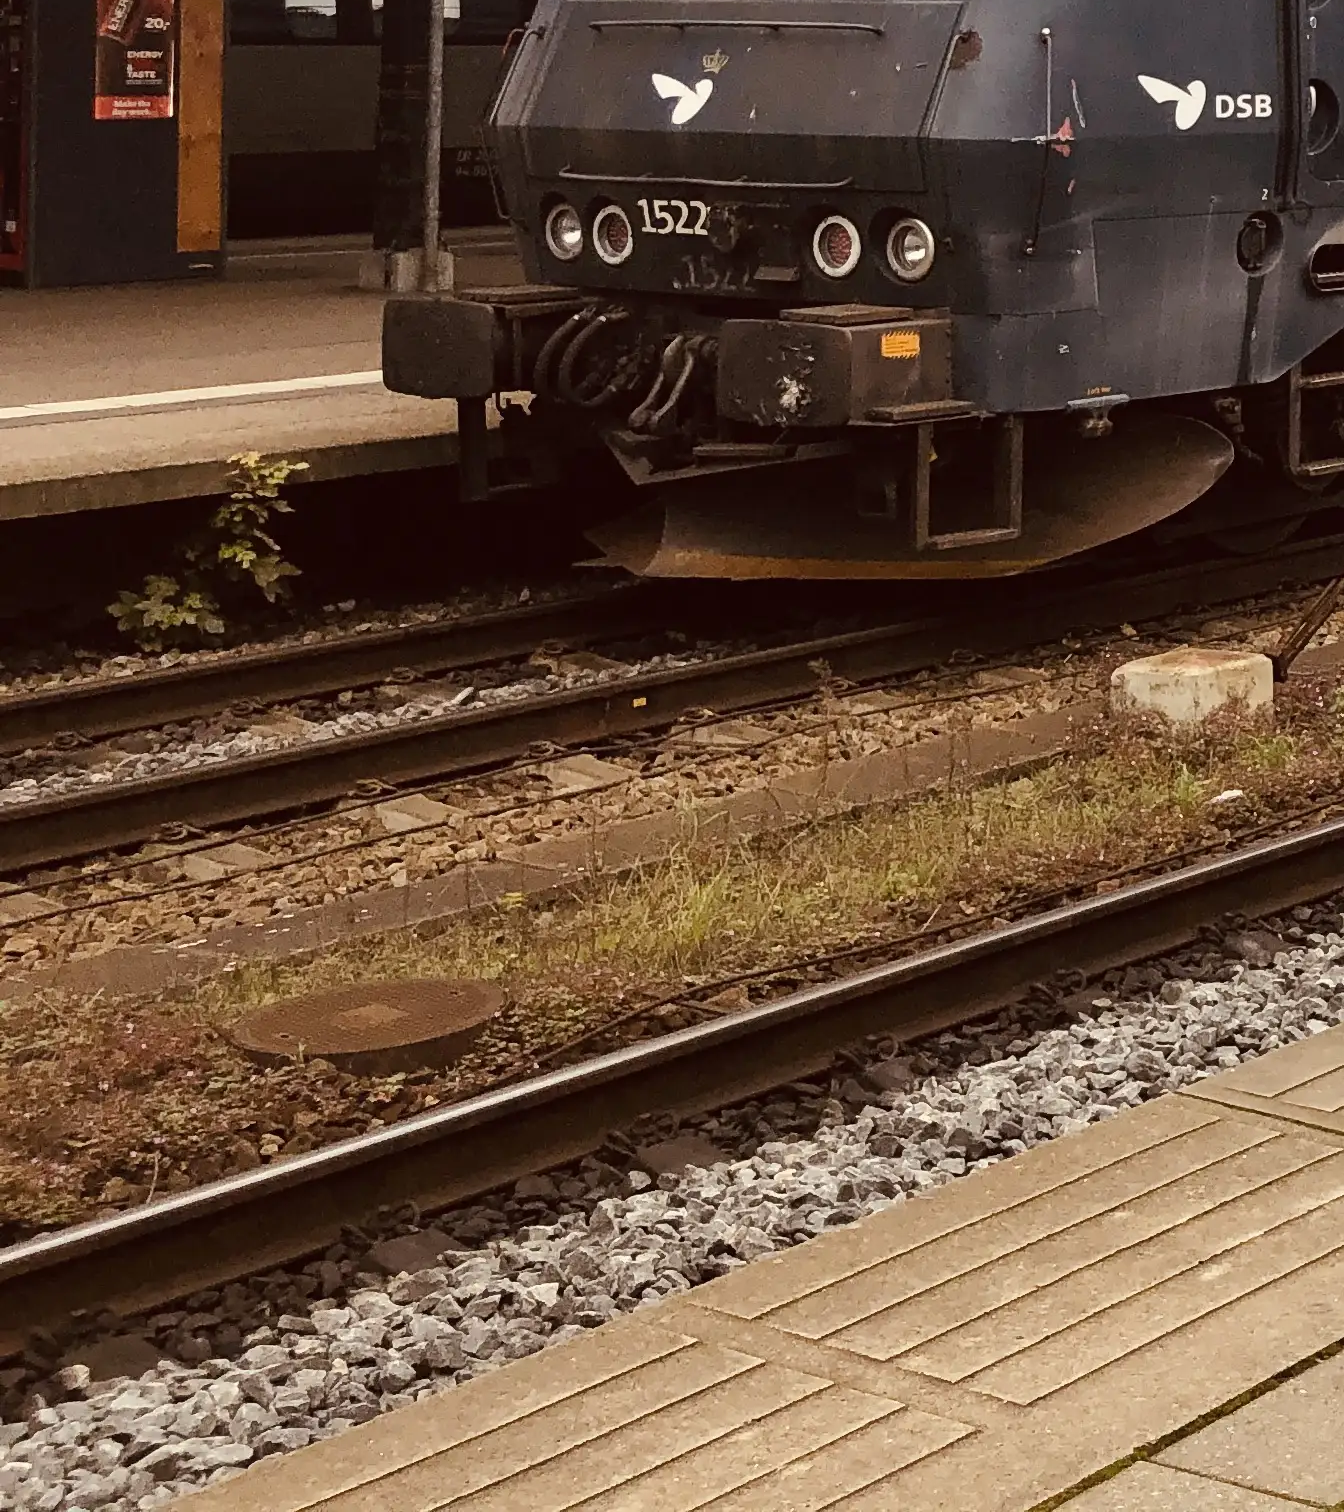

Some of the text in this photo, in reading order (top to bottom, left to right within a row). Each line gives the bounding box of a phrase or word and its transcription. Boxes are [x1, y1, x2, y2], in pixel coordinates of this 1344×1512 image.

[128, 70, 156, 79] TASTE
[1215, 94, 1273, 119] DSB
[1261, 188, 1269, 201] 2
[637, 198, 709, 236] 1522
